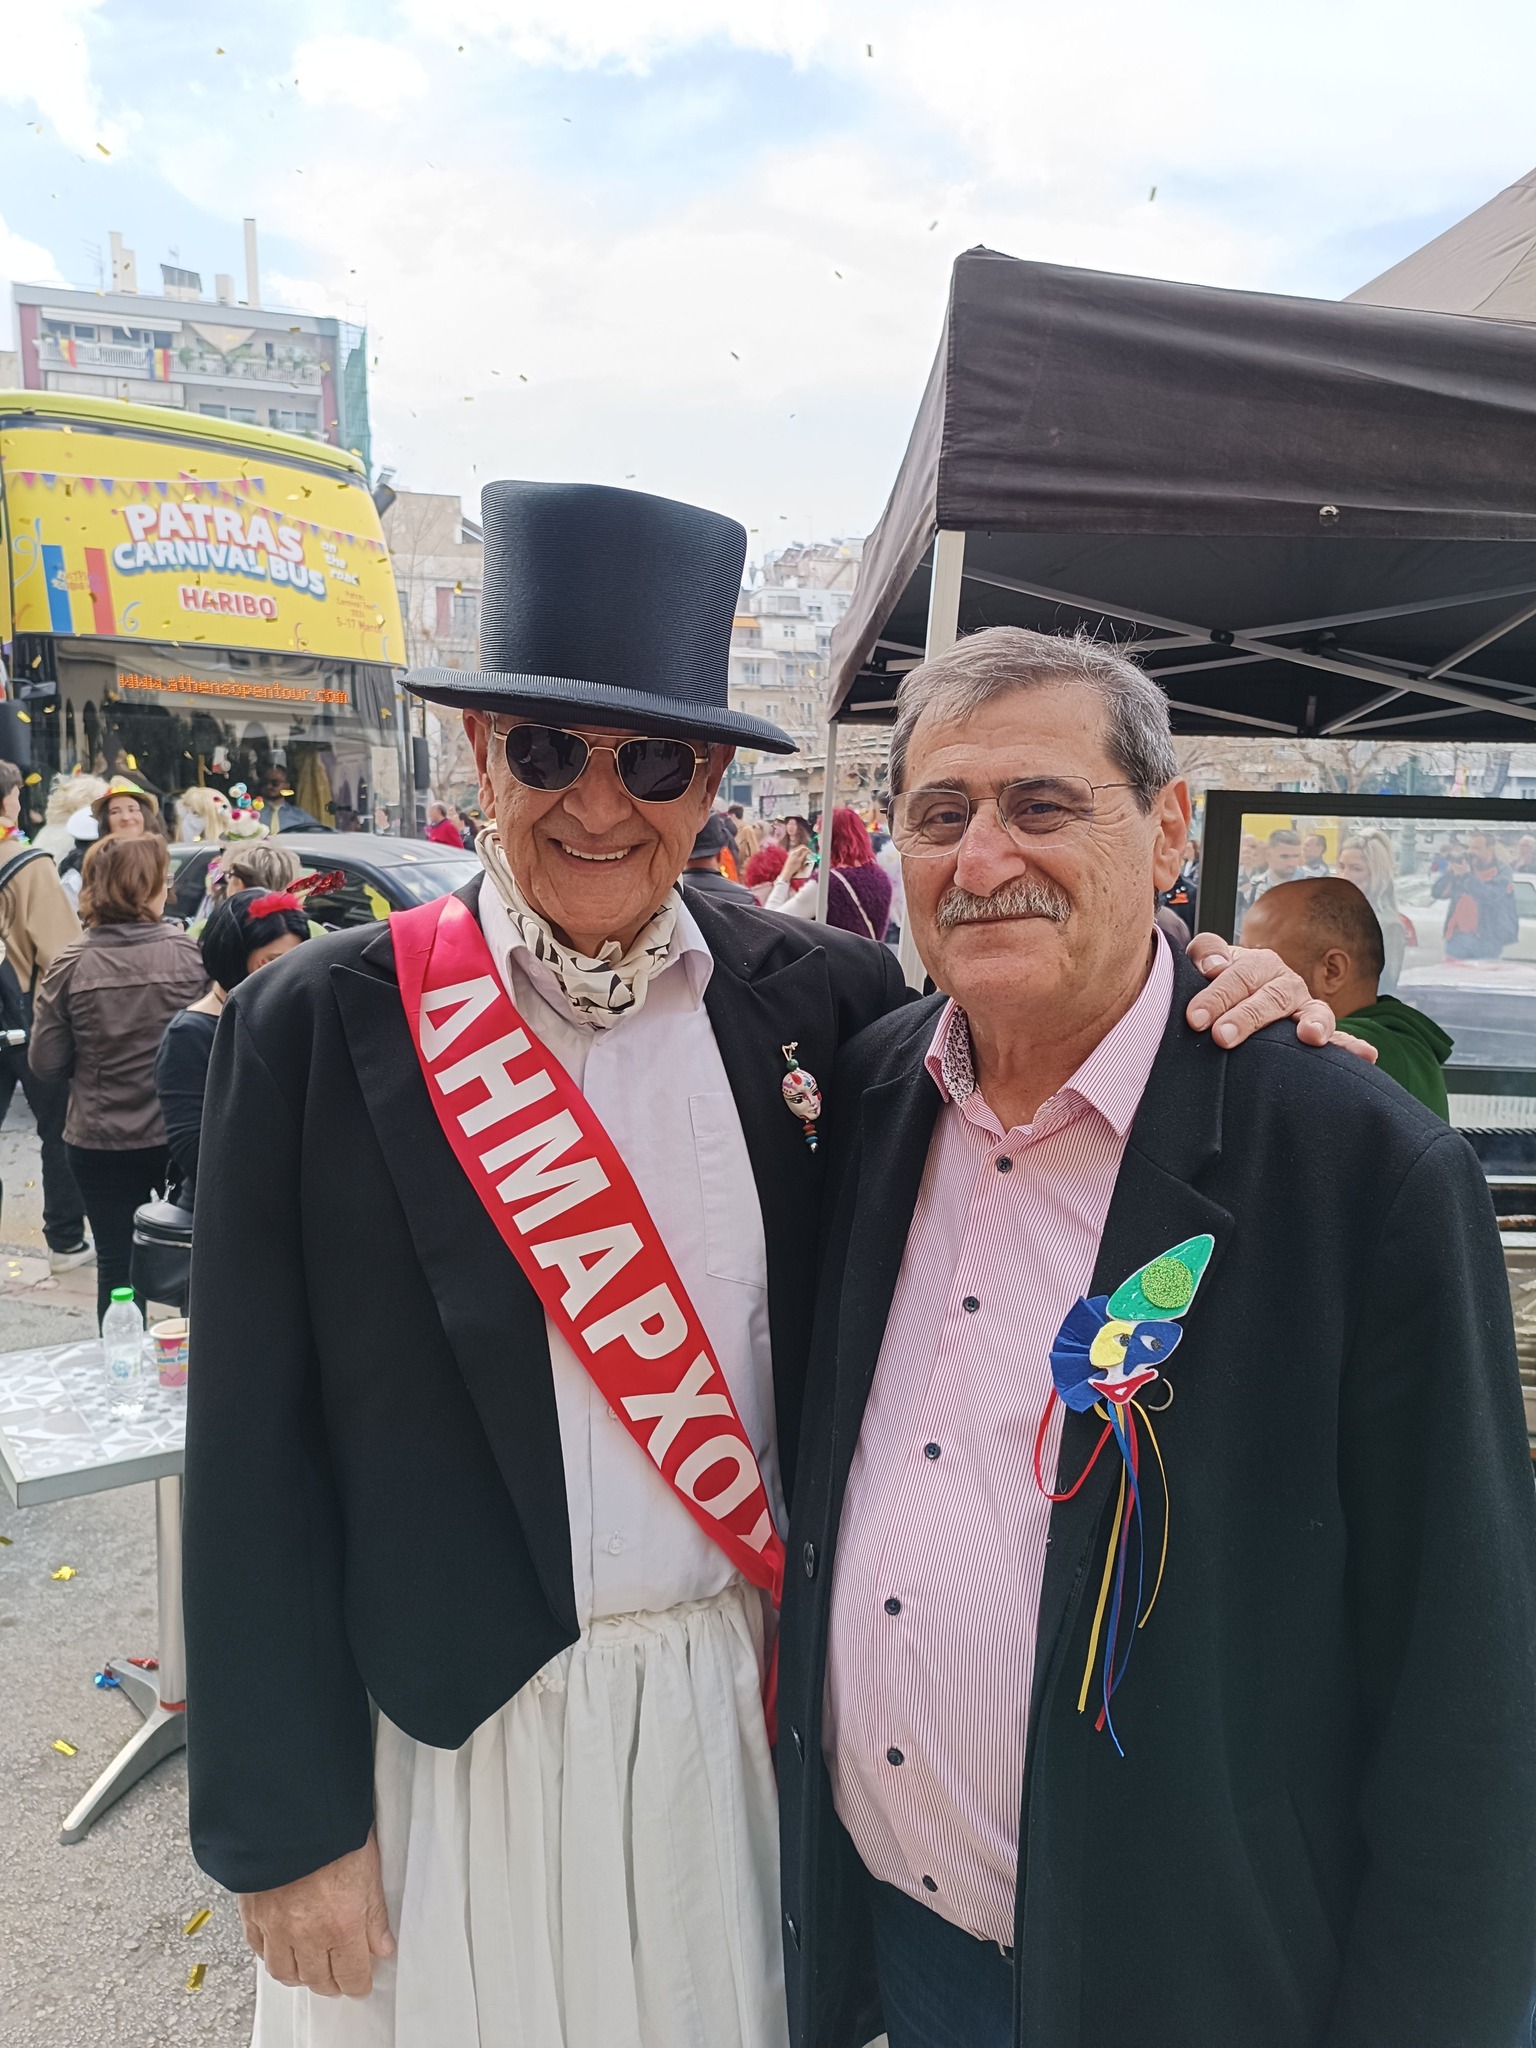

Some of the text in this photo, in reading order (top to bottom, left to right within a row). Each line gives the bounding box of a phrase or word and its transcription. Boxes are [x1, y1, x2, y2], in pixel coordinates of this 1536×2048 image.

[124, 502, 304, 563] PATRAS
[320, 541, 338, 554] on
[113, 541, 327, 600] CARNIVAL BUS
[324, 553, 347, 569] the
[181, 587, 277, 619] HARIBO
[117, 672, 348, 704] www.athensopentour.com
